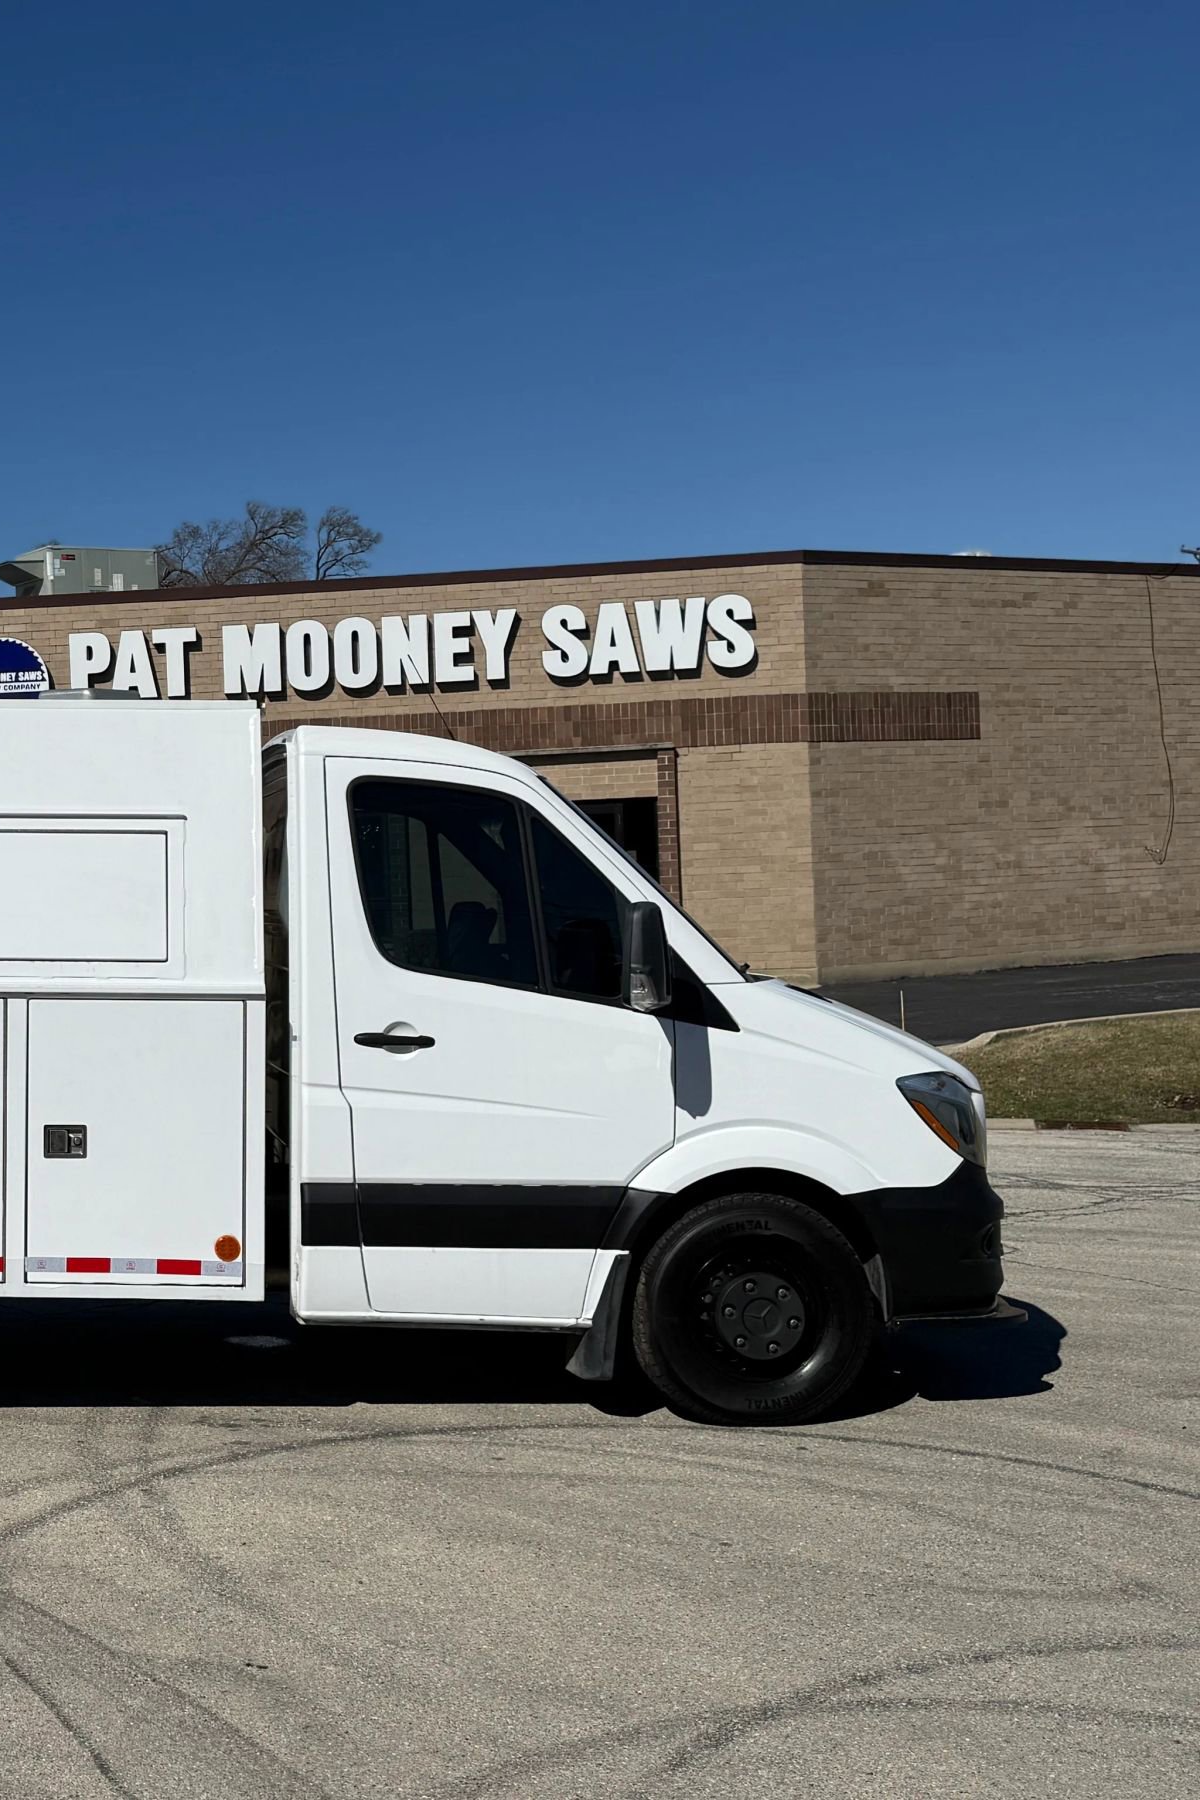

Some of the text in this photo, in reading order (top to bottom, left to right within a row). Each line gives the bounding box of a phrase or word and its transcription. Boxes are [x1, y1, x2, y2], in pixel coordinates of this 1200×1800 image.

[69, 594, 755, 698] PAT MOONEY SAWS
[18, 671, 42, 681] SAWS
[4, 683, 40, 691] COMPANY
